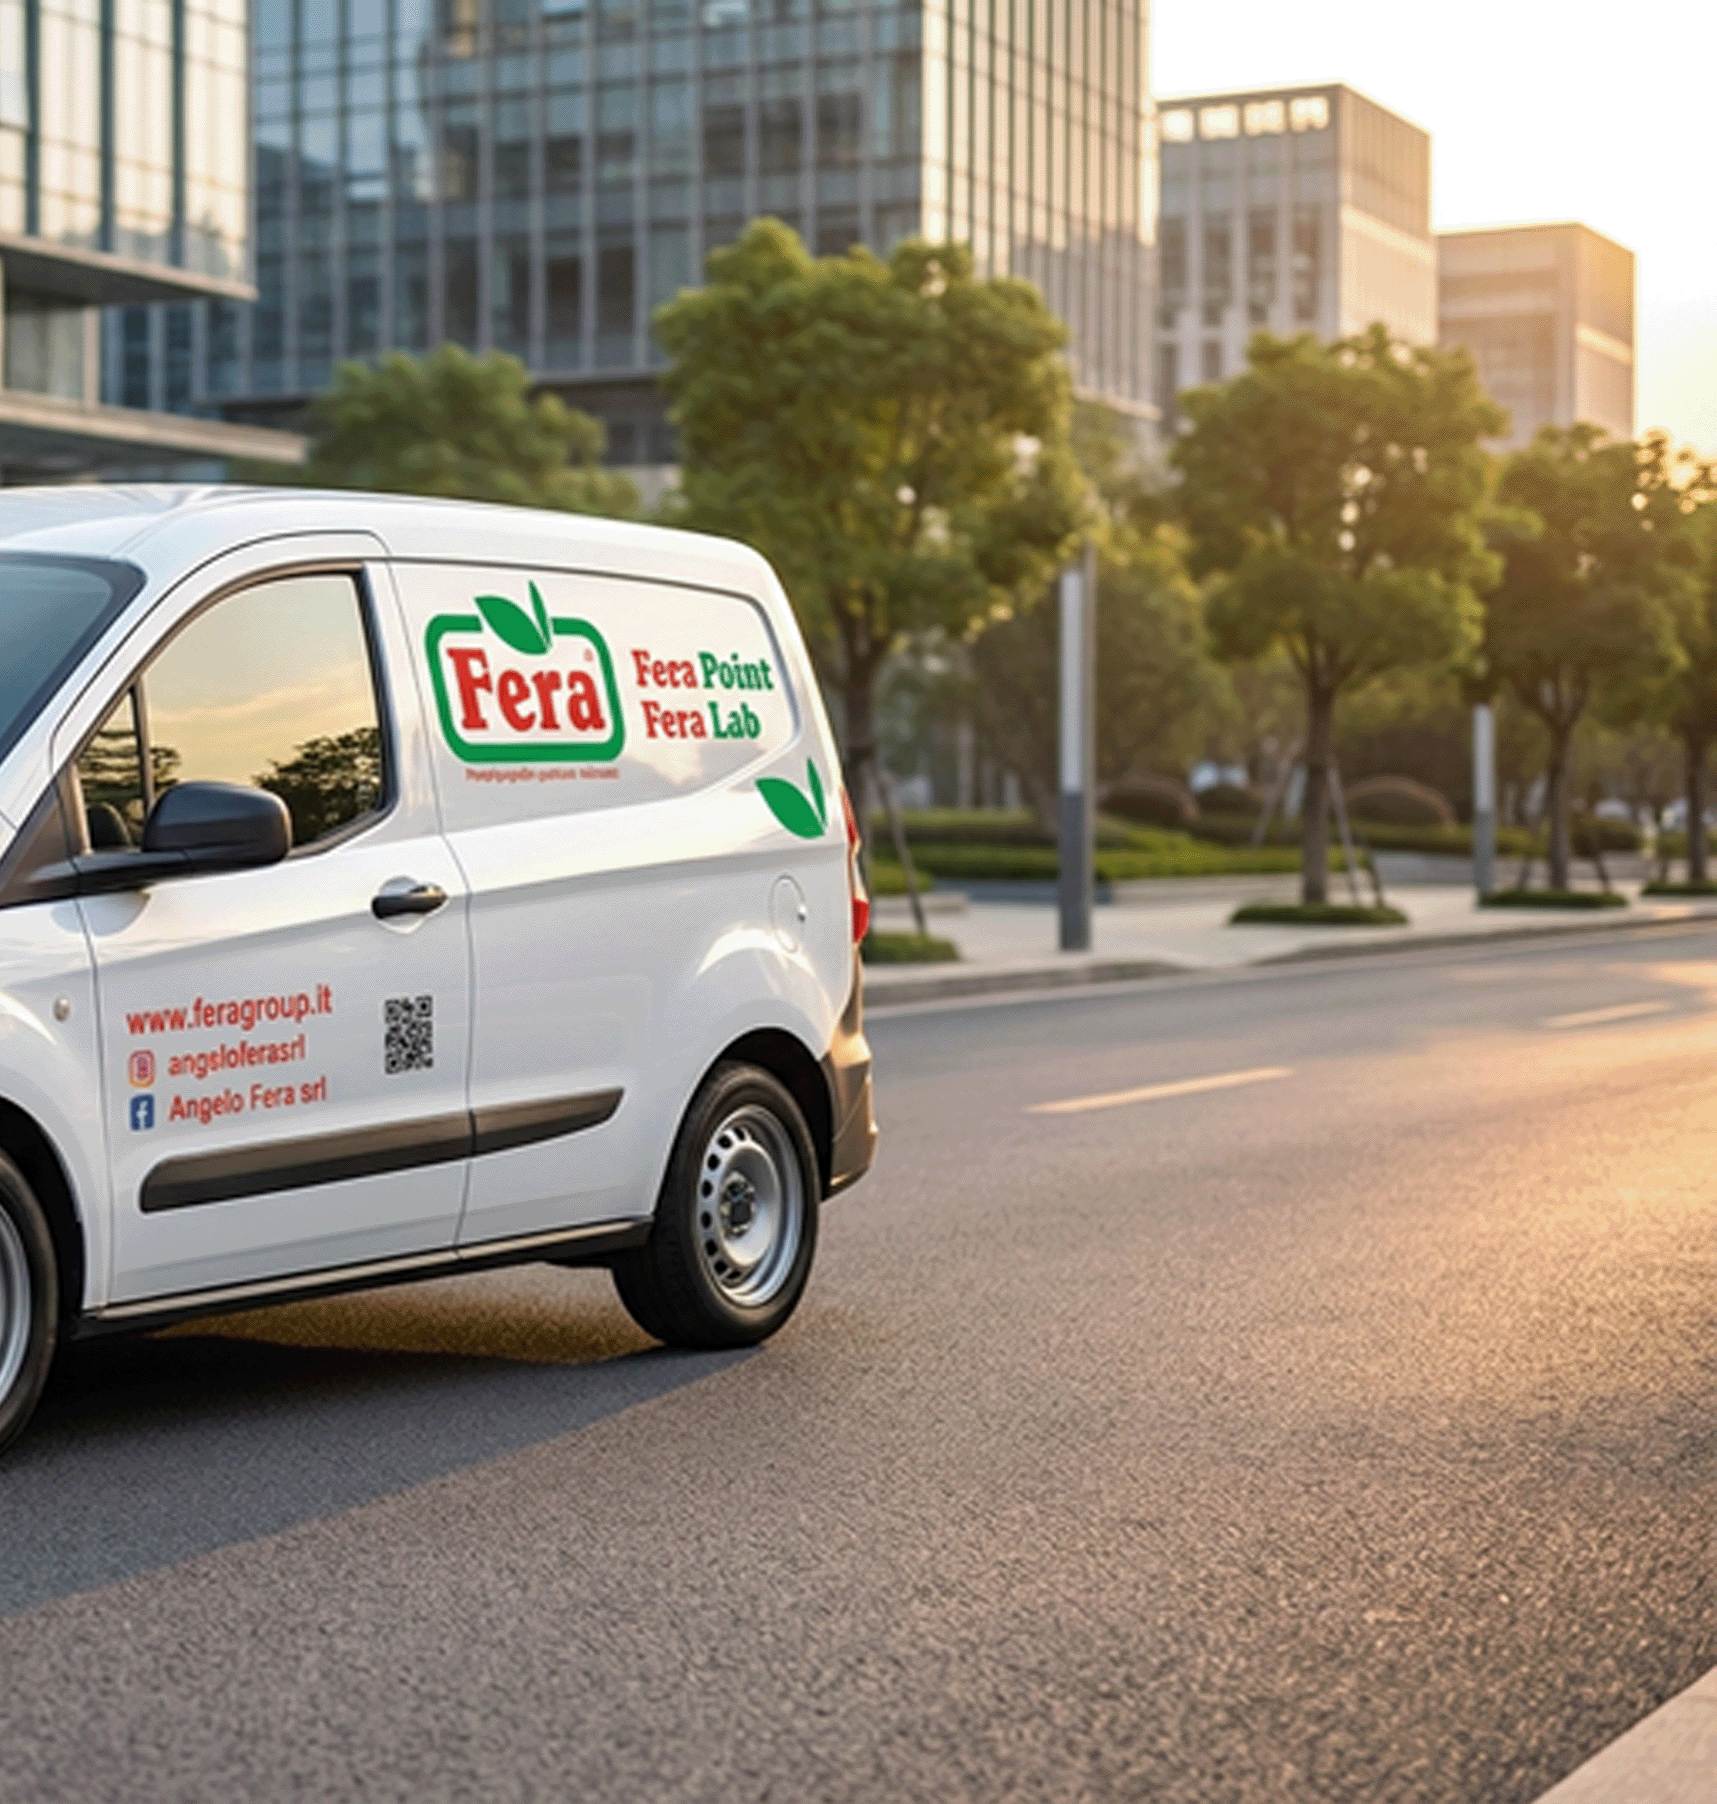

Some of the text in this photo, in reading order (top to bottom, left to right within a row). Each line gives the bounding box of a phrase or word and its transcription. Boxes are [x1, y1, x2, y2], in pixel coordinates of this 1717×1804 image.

[447, 647, 606, 732] Fera
[630, 648, 775, 691] Fera Point
[640, 699, 762, 740] Fera Lab
[125, 983, 333, 1036] www.feragroup.it
[167, 1074, 327, 1125] Angelo Fera srl
